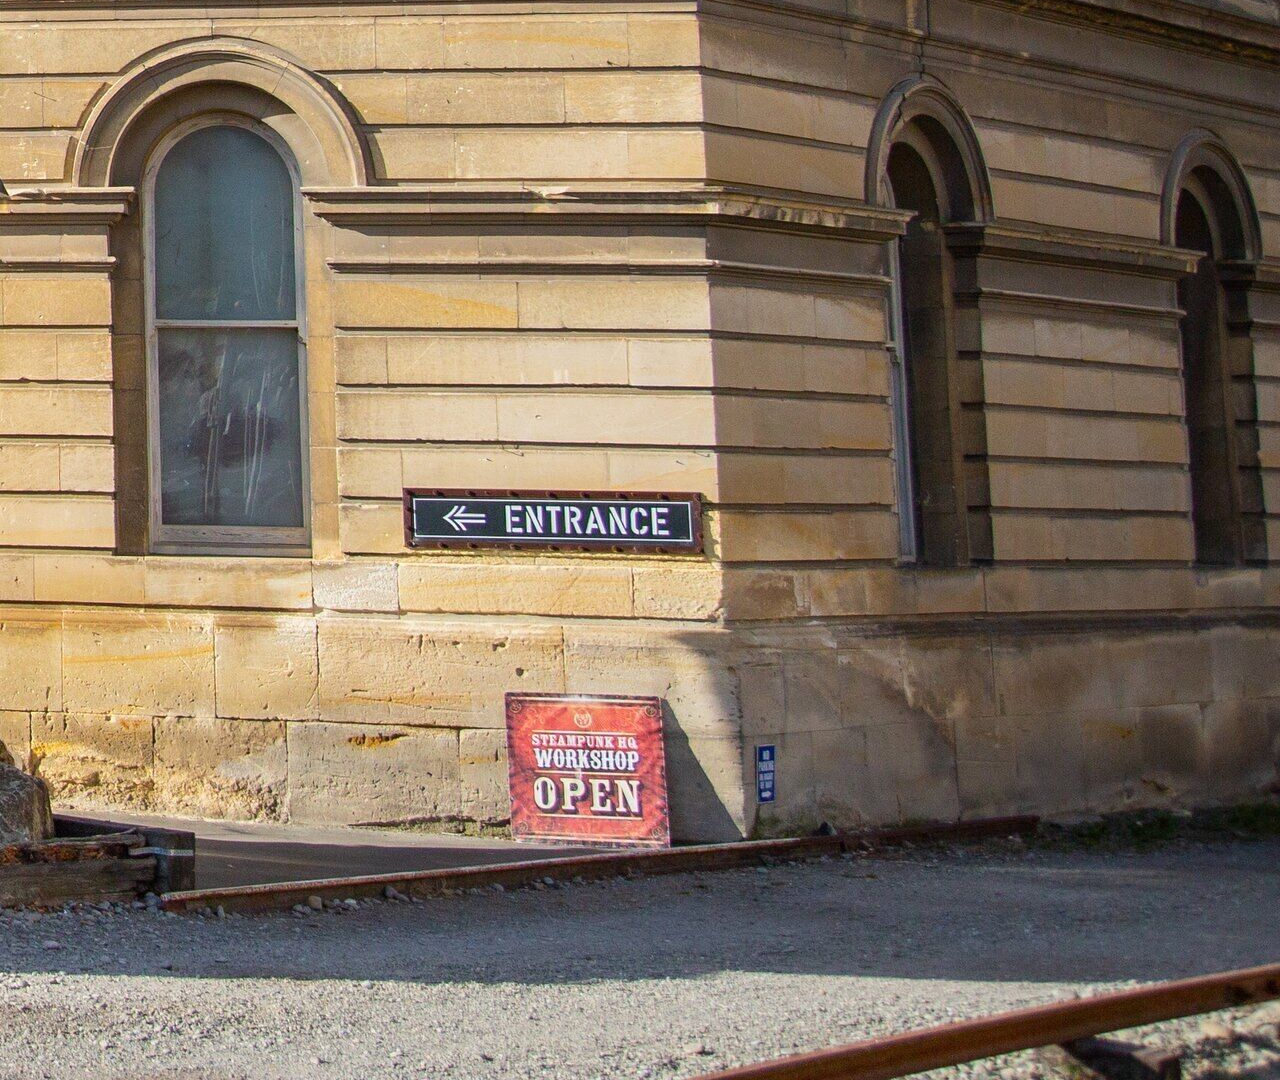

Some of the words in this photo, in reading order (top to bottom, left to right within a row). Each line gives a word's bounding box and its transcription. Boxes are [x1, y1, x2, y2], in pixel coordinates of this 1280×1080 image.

[504, 504, 670, 536] ENTRANCE
[531, 733, 615, 749] STEAMPUNK
[616, 735, 639, 750] HQ
[533, 747, 640, 772] WORKSHOP
[533, 776, 641, 814] OPEN
